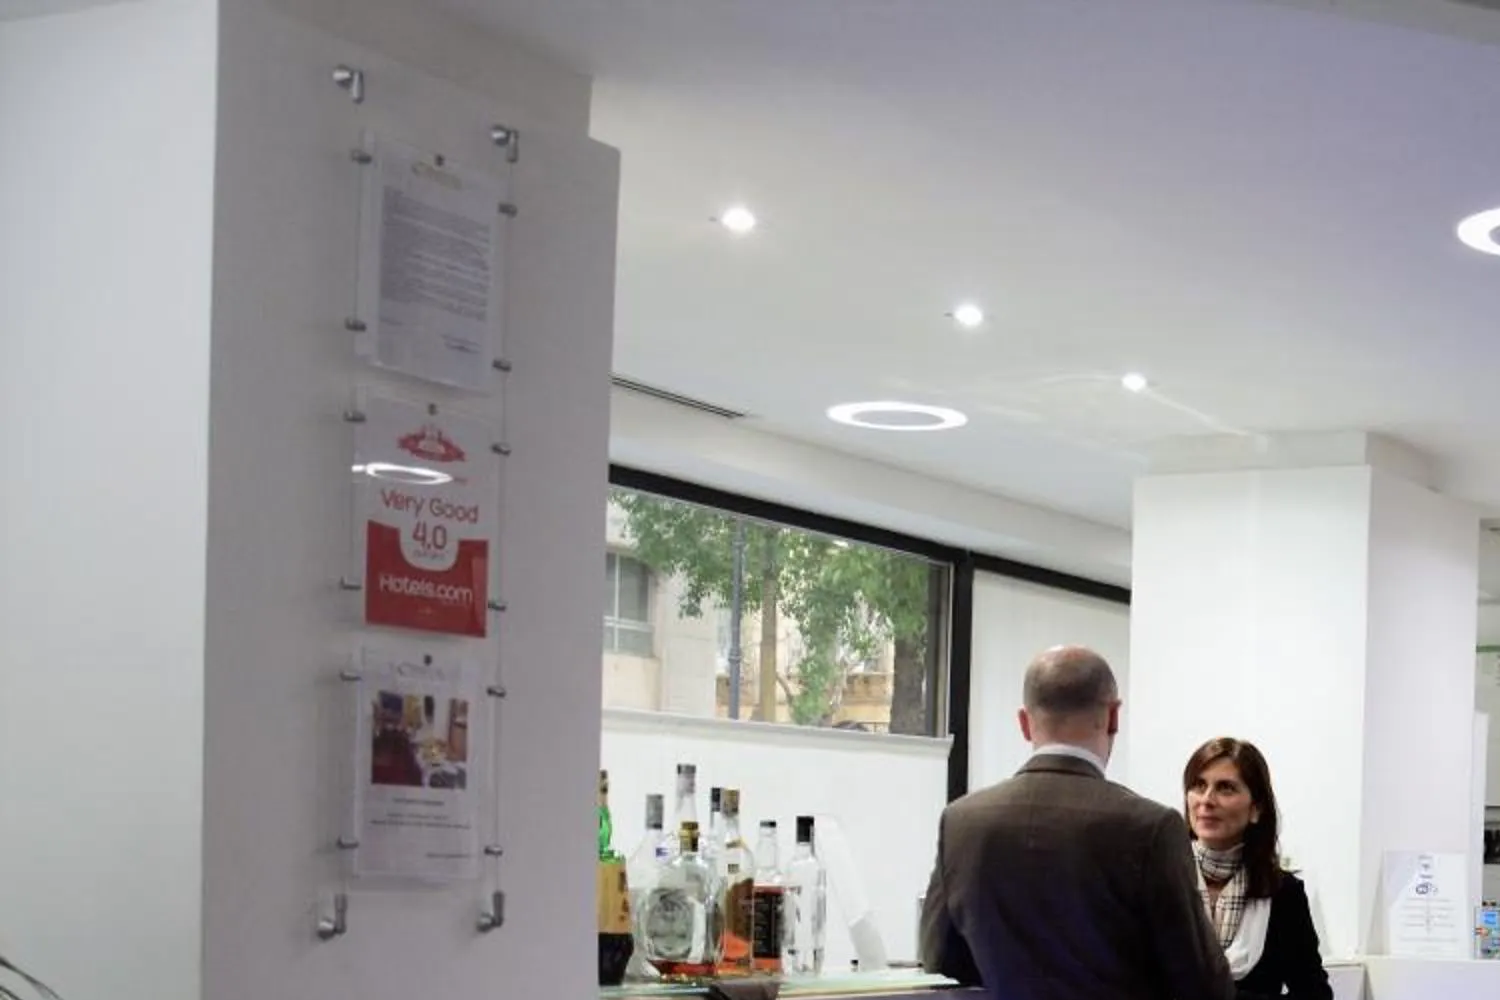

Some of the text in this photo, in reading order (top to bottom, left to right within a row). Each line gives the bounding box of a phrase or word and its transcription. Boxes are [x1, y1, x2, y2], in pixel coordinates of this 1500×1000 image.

[380, 489, 479, 524] Very Good
[412, 521, 447, 549] 4.0
[379, 574, 473, 605] Hotels.com
